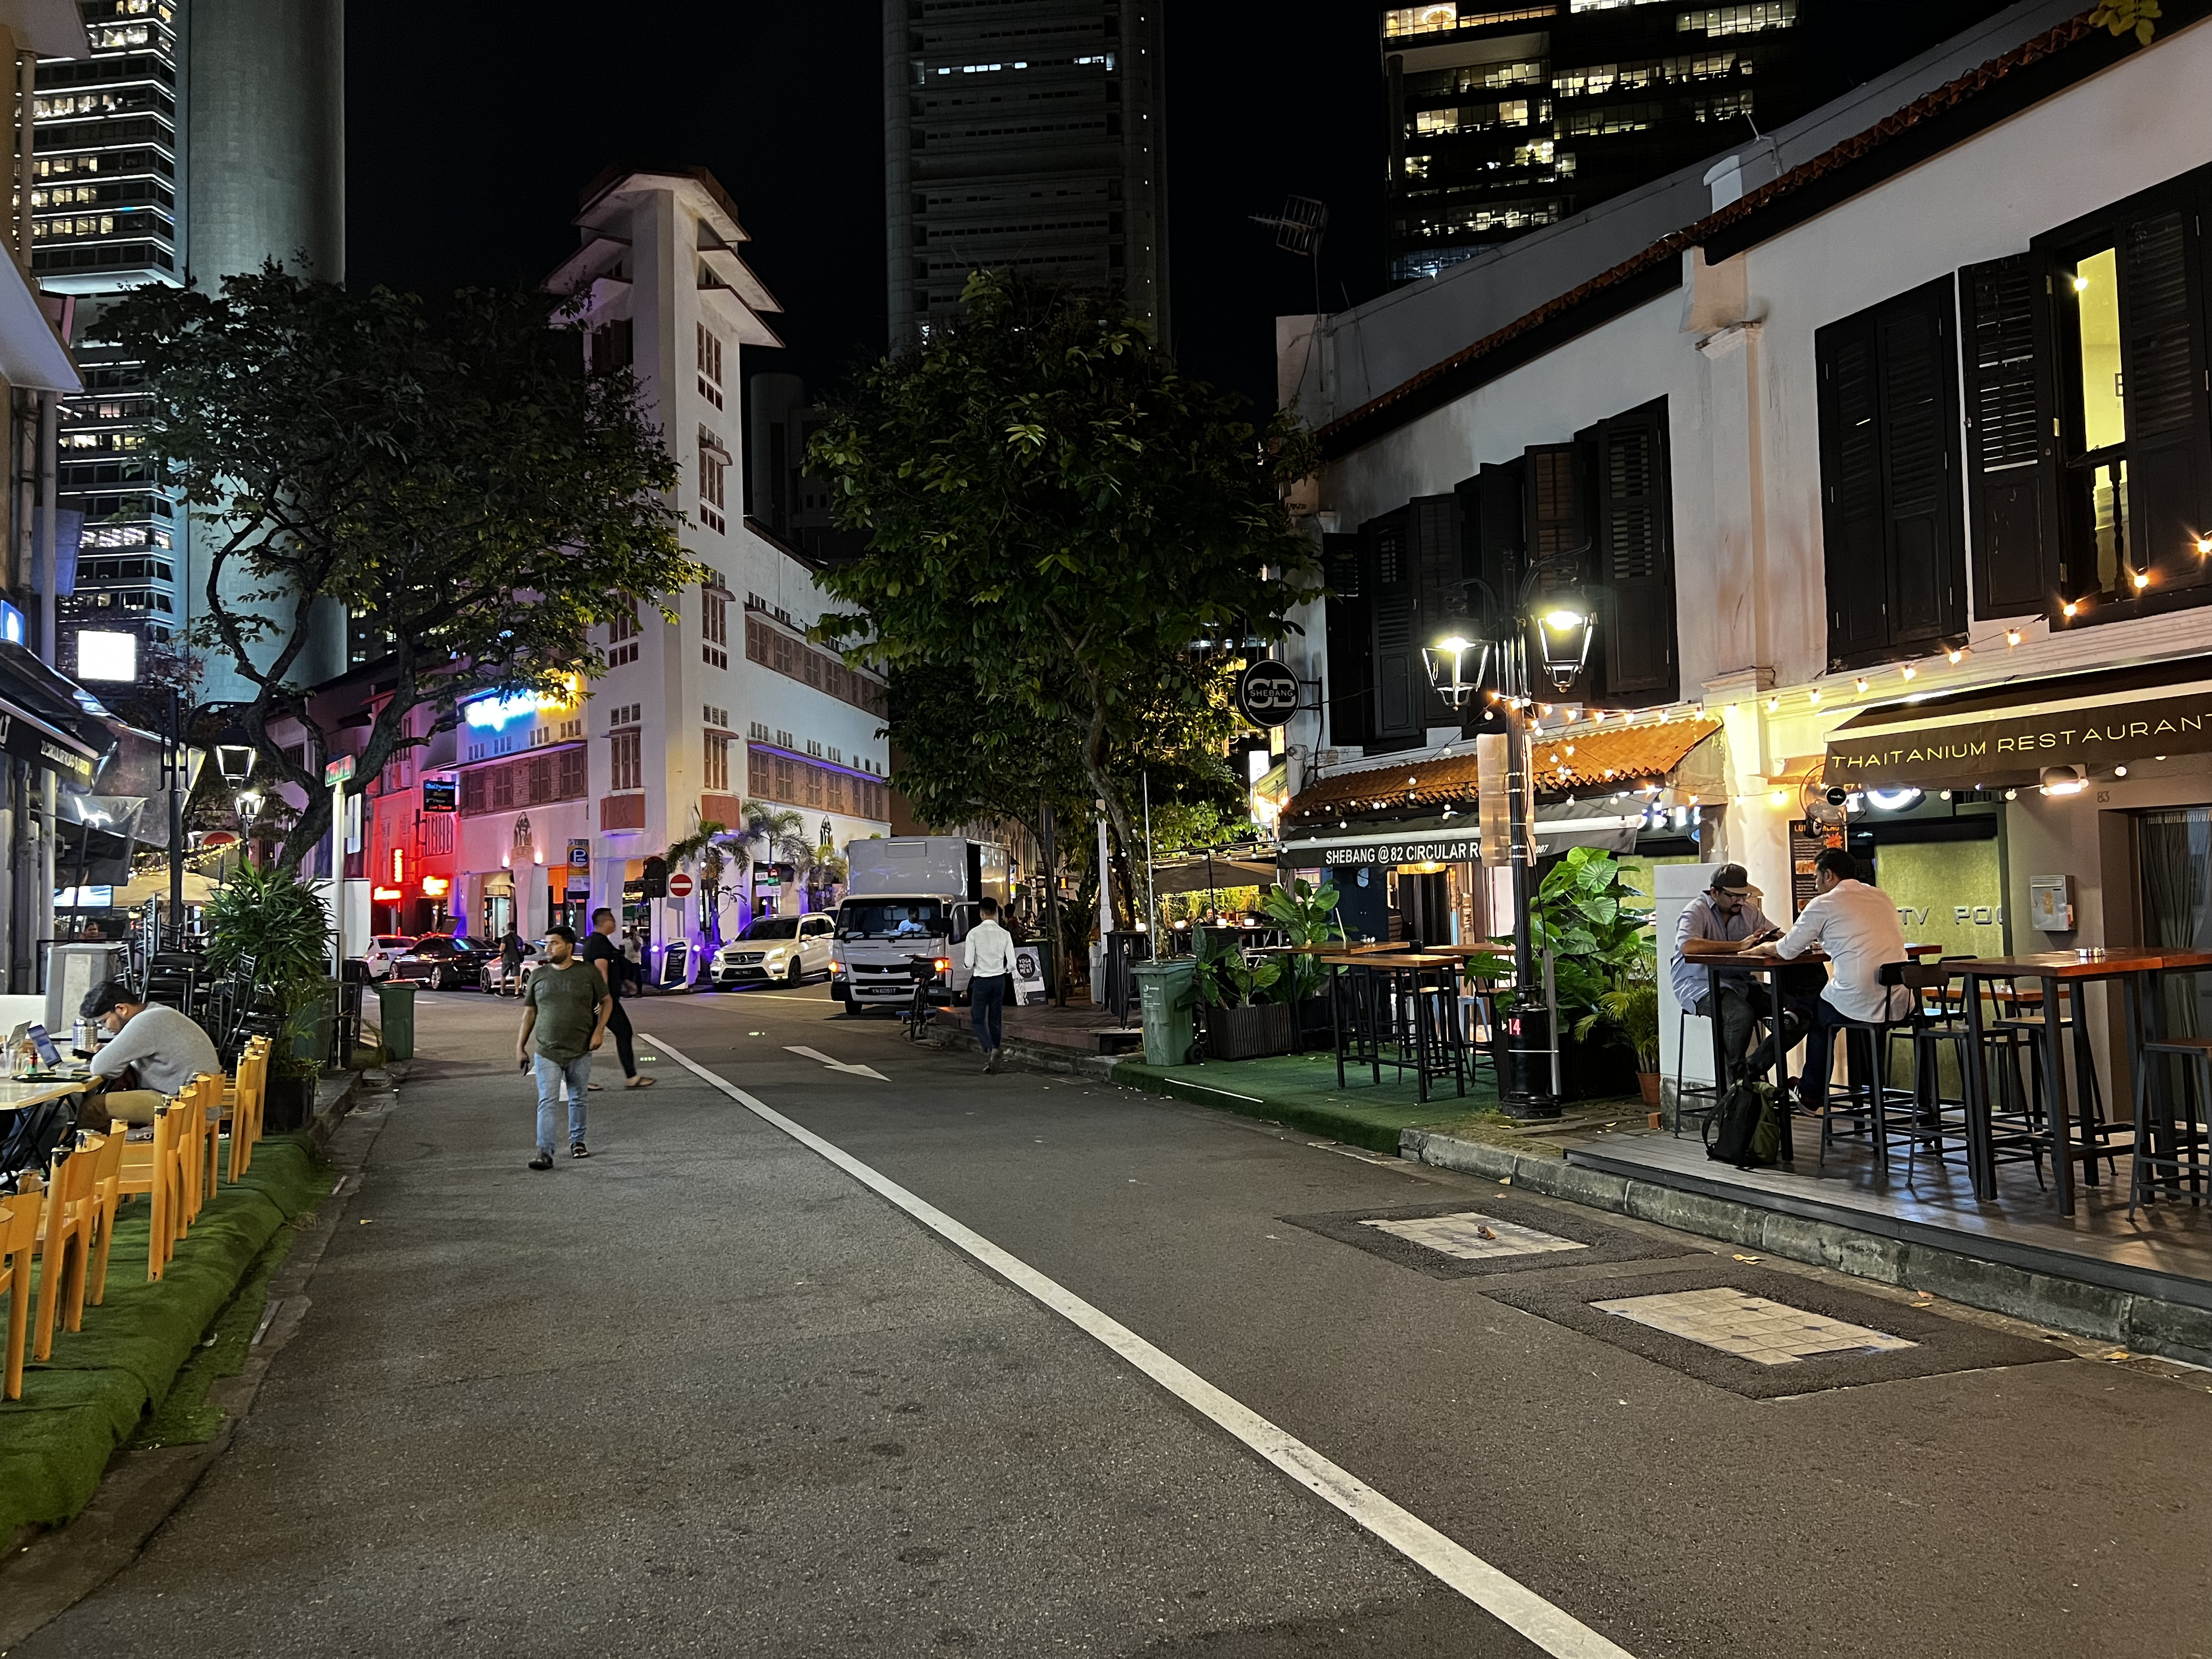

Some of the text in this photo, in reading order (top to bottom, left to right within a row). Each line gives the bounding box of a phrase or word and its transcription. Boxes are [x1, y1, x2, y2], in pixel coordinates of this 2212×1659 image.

[1832, 741, 1986, 769] THAITANIUM
[2097, 790, 2110, 804] 83
[1326, 848, 1375, 864] SHEBANG
[1406, 842, 1467, 861] CIRCULAR
